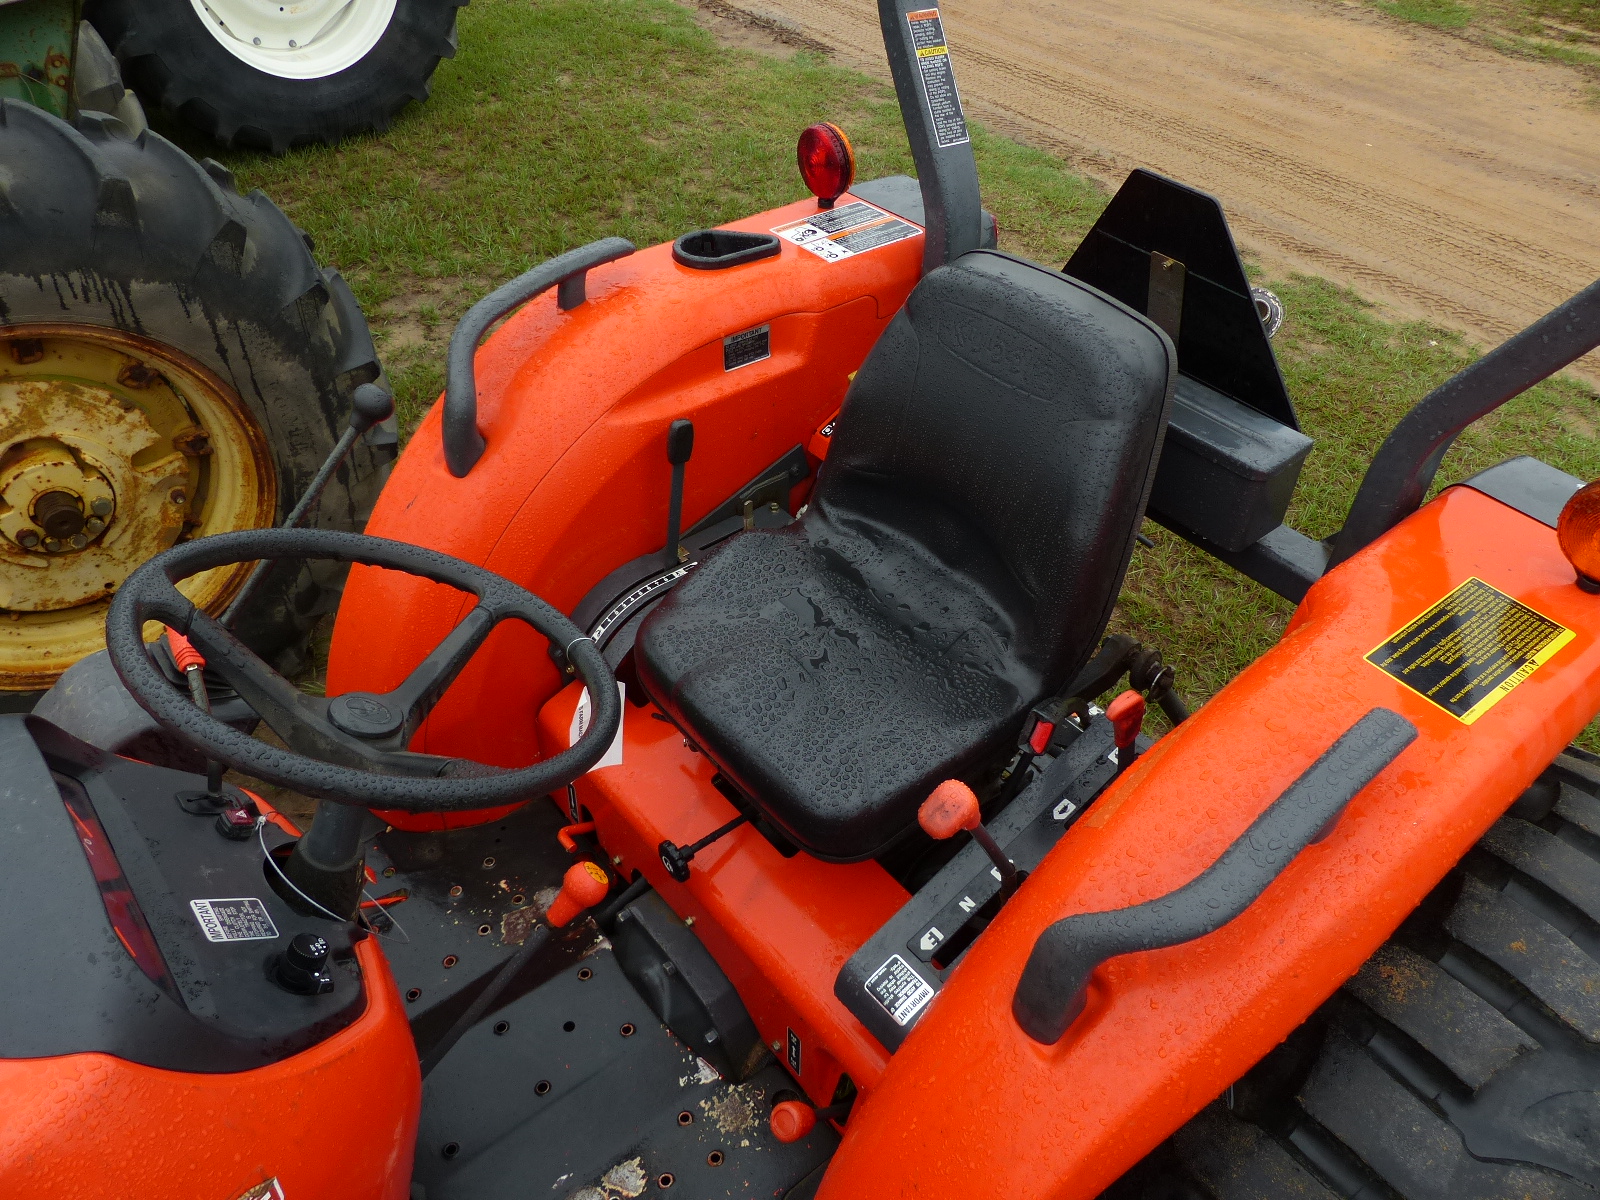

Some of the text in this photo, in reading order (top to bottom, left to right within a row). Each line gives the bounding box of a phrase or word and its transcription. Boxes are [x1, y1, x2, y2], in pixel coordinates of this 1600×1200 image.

[1500, 664, 1534, 692] CAUTION
[959, 896, 976, 912] N
[194, 901, 224, 940] IMPORTANT
[895, 987, 931, 1022] IMPORTANT
